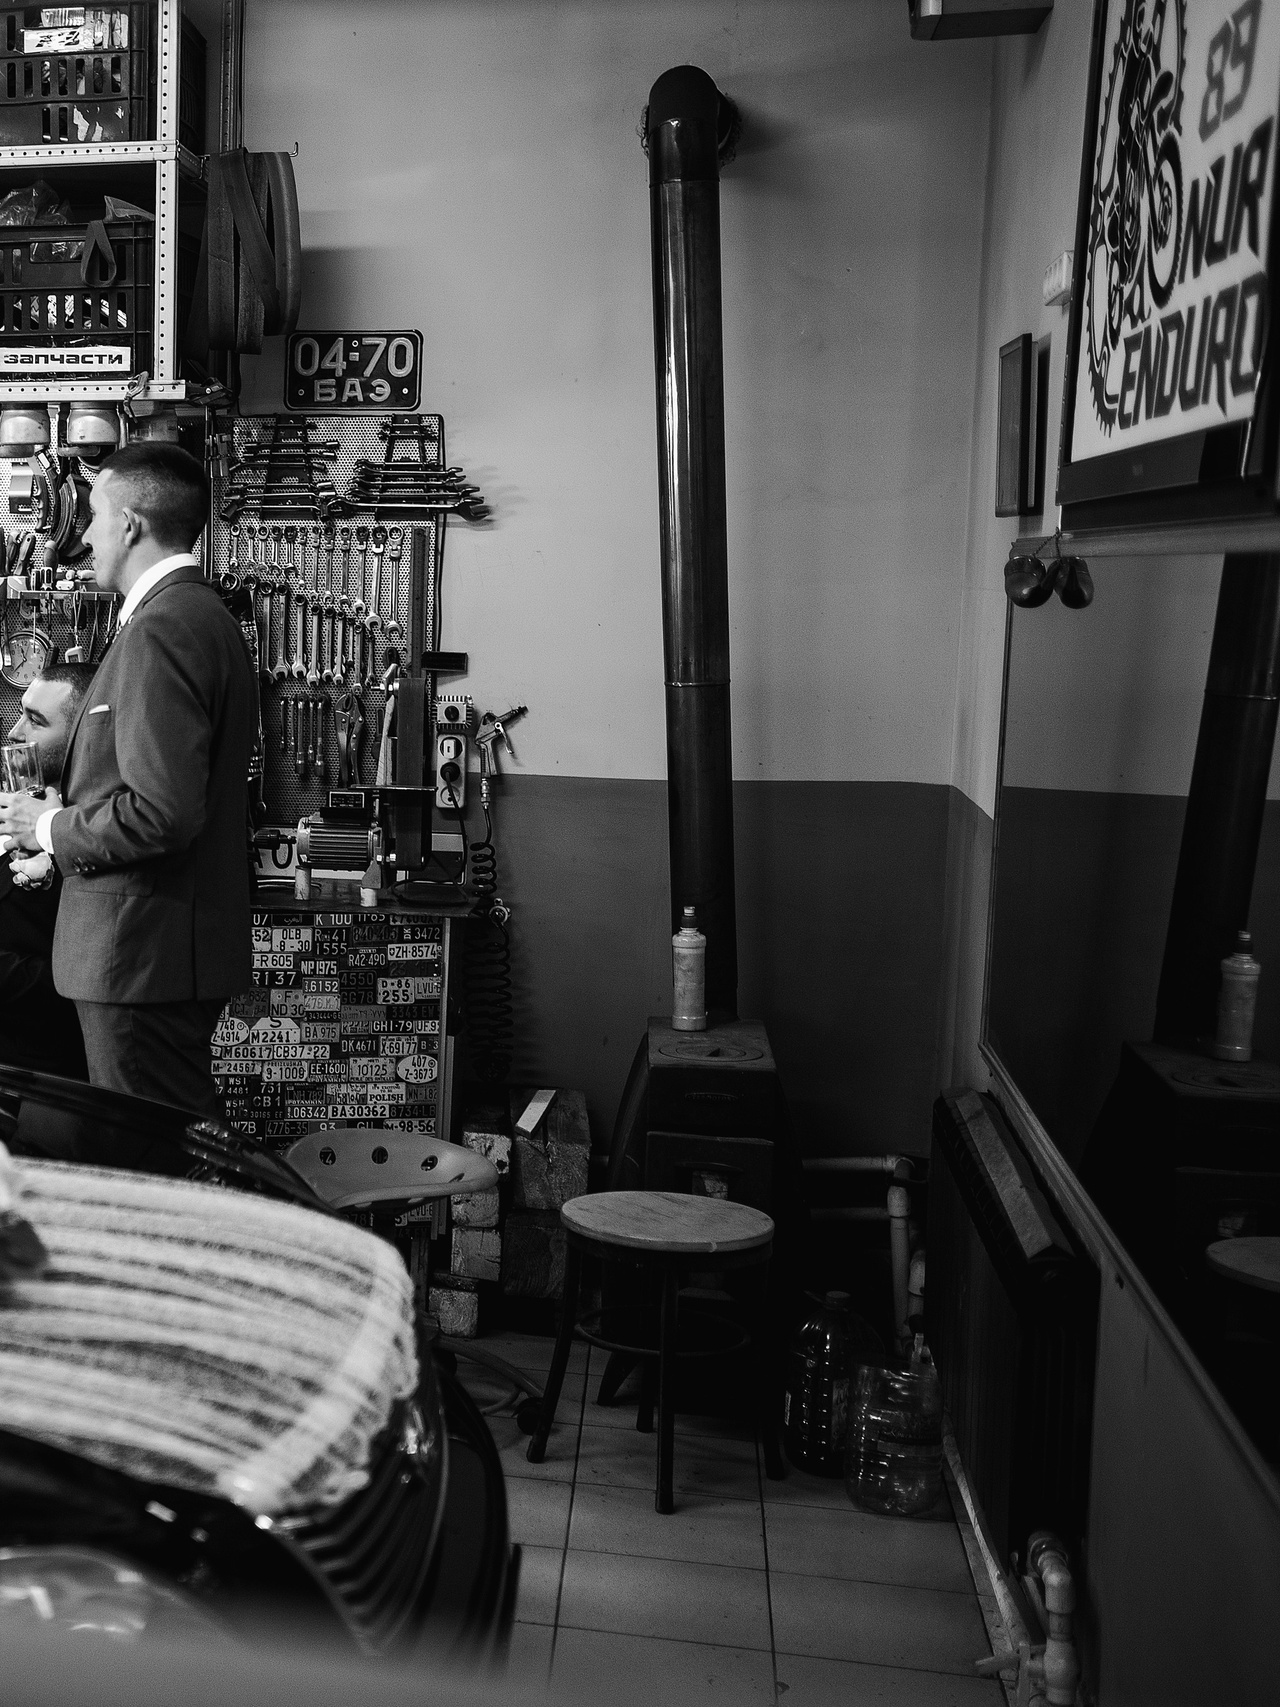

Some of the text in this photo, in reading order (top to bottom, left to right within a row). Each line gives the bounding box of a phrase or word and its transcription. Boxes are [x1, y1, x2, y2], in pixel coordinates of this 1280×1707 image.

[1198, 0, 1262, 142] 89
[1117, 270, 1268, 431] ENDURO
[3, 354, 123, 365] запчасти
[313, 378, 391, 402] БАЭ
[414, 927, 441, 940] 3472
[271, 954, 292, 968] 605
[284, 989, 294, 1003] F
[381, 989, 410, 1004] 255
[357, 1064, 388, 1077] 10125
[369, 1093, 404, 1102] POLISH
